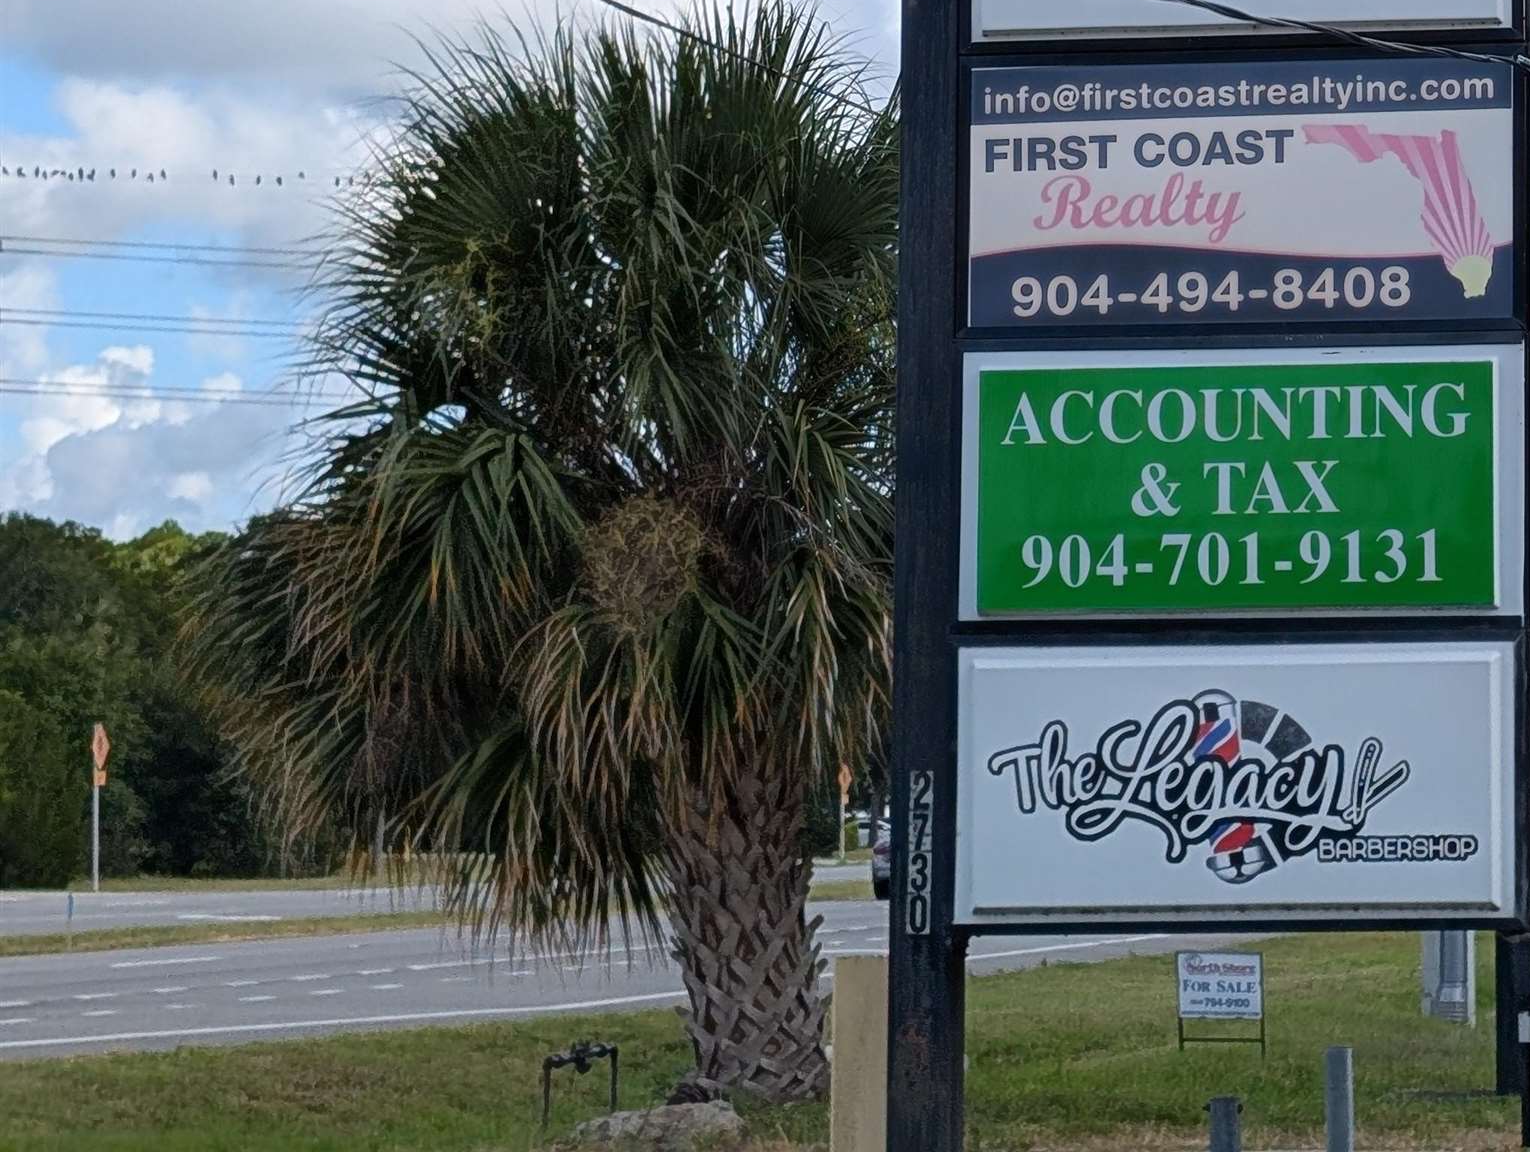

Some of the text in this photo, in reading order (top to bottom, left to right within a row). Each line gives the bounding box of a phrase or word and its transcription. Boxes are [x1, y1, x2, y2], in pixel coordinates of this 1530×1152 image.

[984, 76, 1495, 115] info@firstcoastrealtyinc.com
[985, 129, 1294, 172] FIRST COAST
[1033, 172, 1246, 243] Realty
[1011, 266, 1411, 317] 904-494-8408
[1001, 382, 1471, 446] ACCOUNTING
[1131, 460, 1340, 517] & TAX
[1021, 528, 1443, 588] 904-701-9131
[988, 699, 1356, 862] The Legacy
[909, 770, 931, 934] 2730
[1318, 833, 1478, 862] BARBERSHOP
